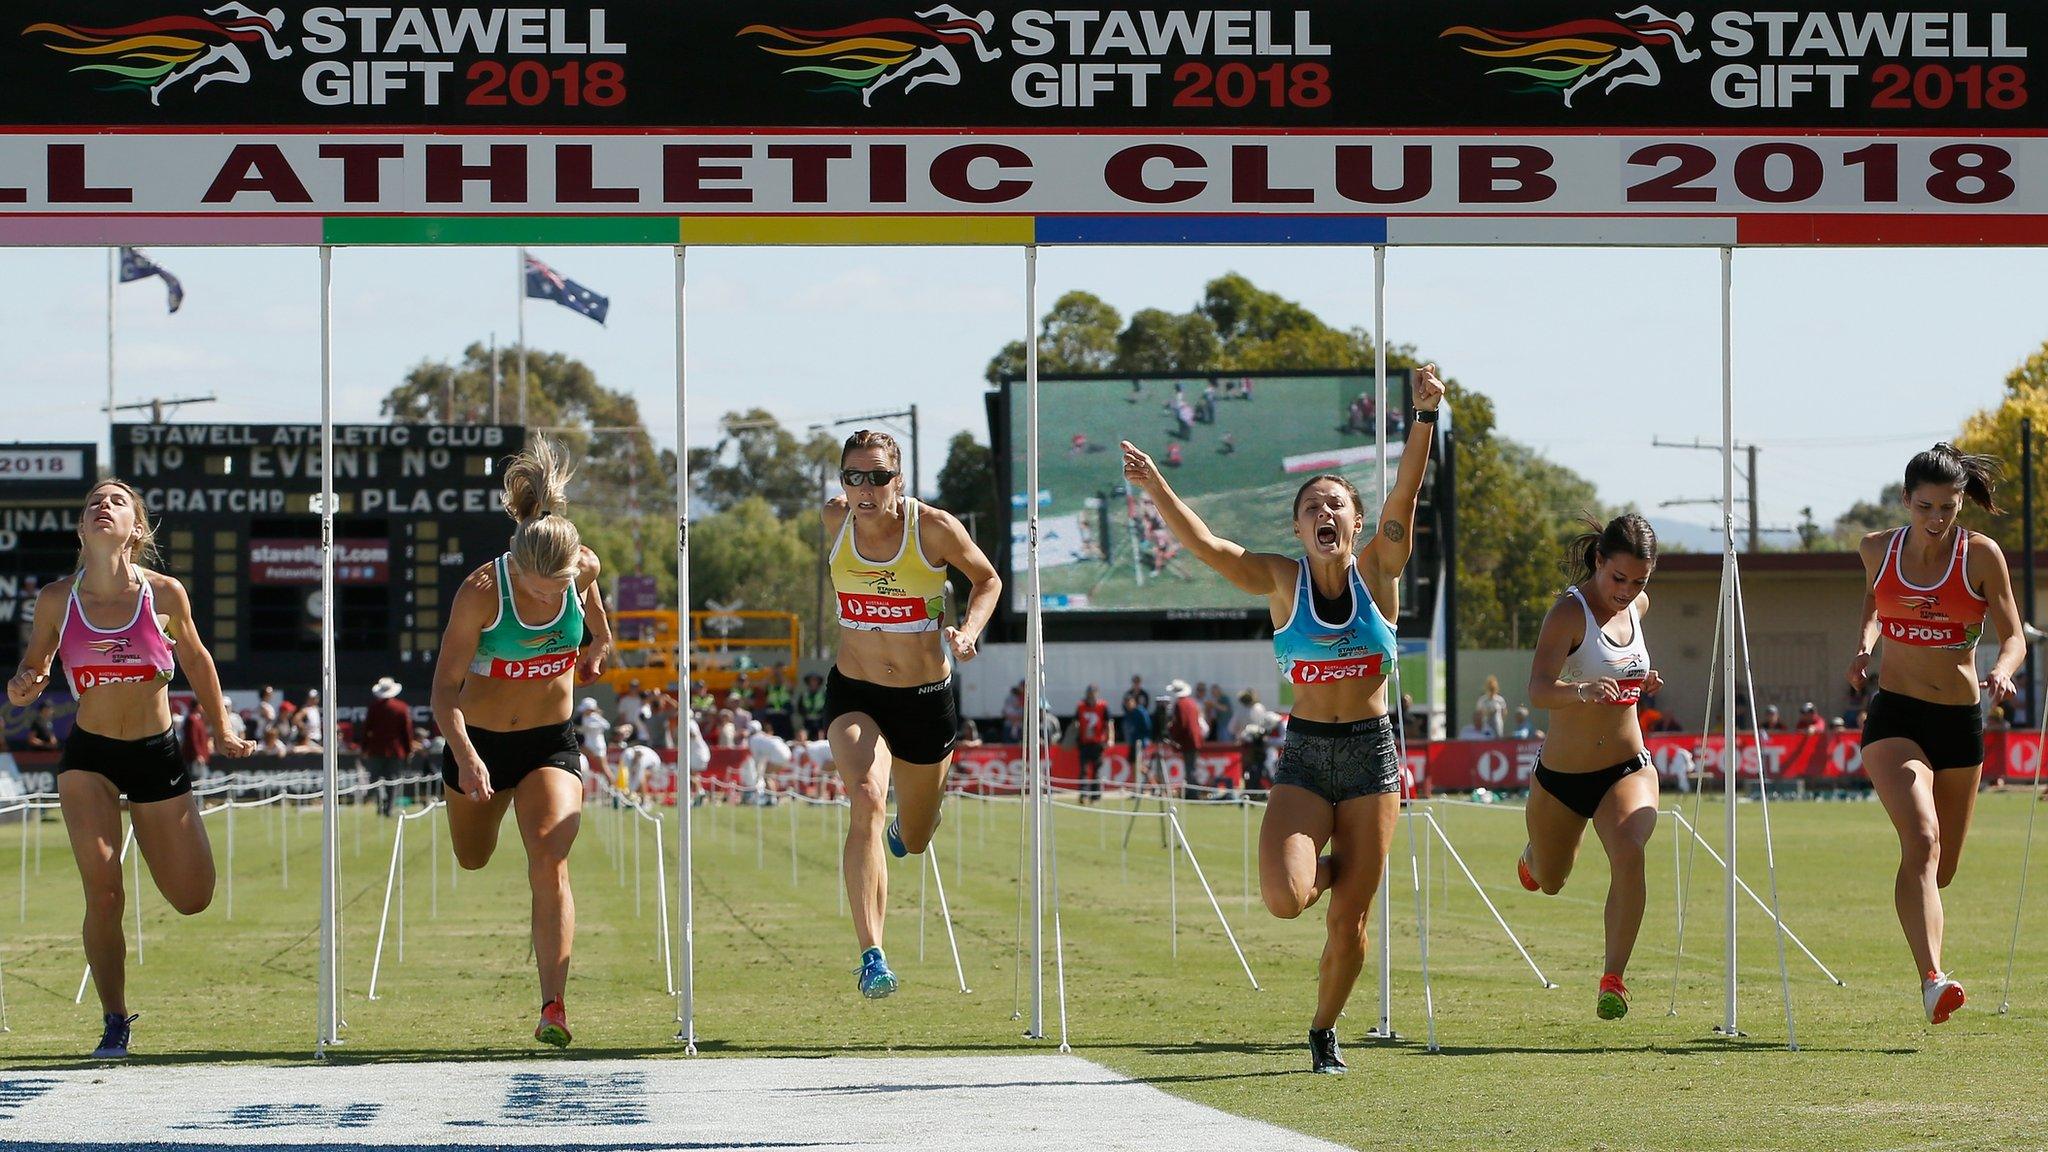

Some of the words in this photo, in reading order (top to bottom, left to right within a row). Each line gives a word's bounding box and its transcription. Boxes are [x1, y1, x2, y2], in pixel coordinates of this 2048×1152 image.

[302, 7, 626, 54] STAWELL
[1012, 9, 1332, 55] STAWELL
[1710, 11, 2027, 57] STAWELL
[302, 61, 453, 105] GIFT
[467, 61, 626, 106] 2018
[1012, 62, 1161, 107] GIFT
[1173, 63, 1331, 107] 2018
[1710, 64, 1858, 108] GIFT
[1872, 64, 2028, 109] 2018
[201, 143, 1033, 204] ATHLETIC
[1103, 143, 1557, 204] CLUB
[1626, 143, 2016, 204] 2018
[131, 427, 259, 444] STAWELL
[272, 427, 410, 446] ATHLETIC
[428, 427, 504, 446] CLUB
[133, 488, 284, 512] CRATCHD
[866, 605, 913, 618] POST
[1908, 627, 1953, 640] POST
[527, 657, 570, 678] POST
[1320, 664, 1368, 680] POST
[918, 682, 944, 695] NIKE
[1352, 719, 1378, 732] NIKE
